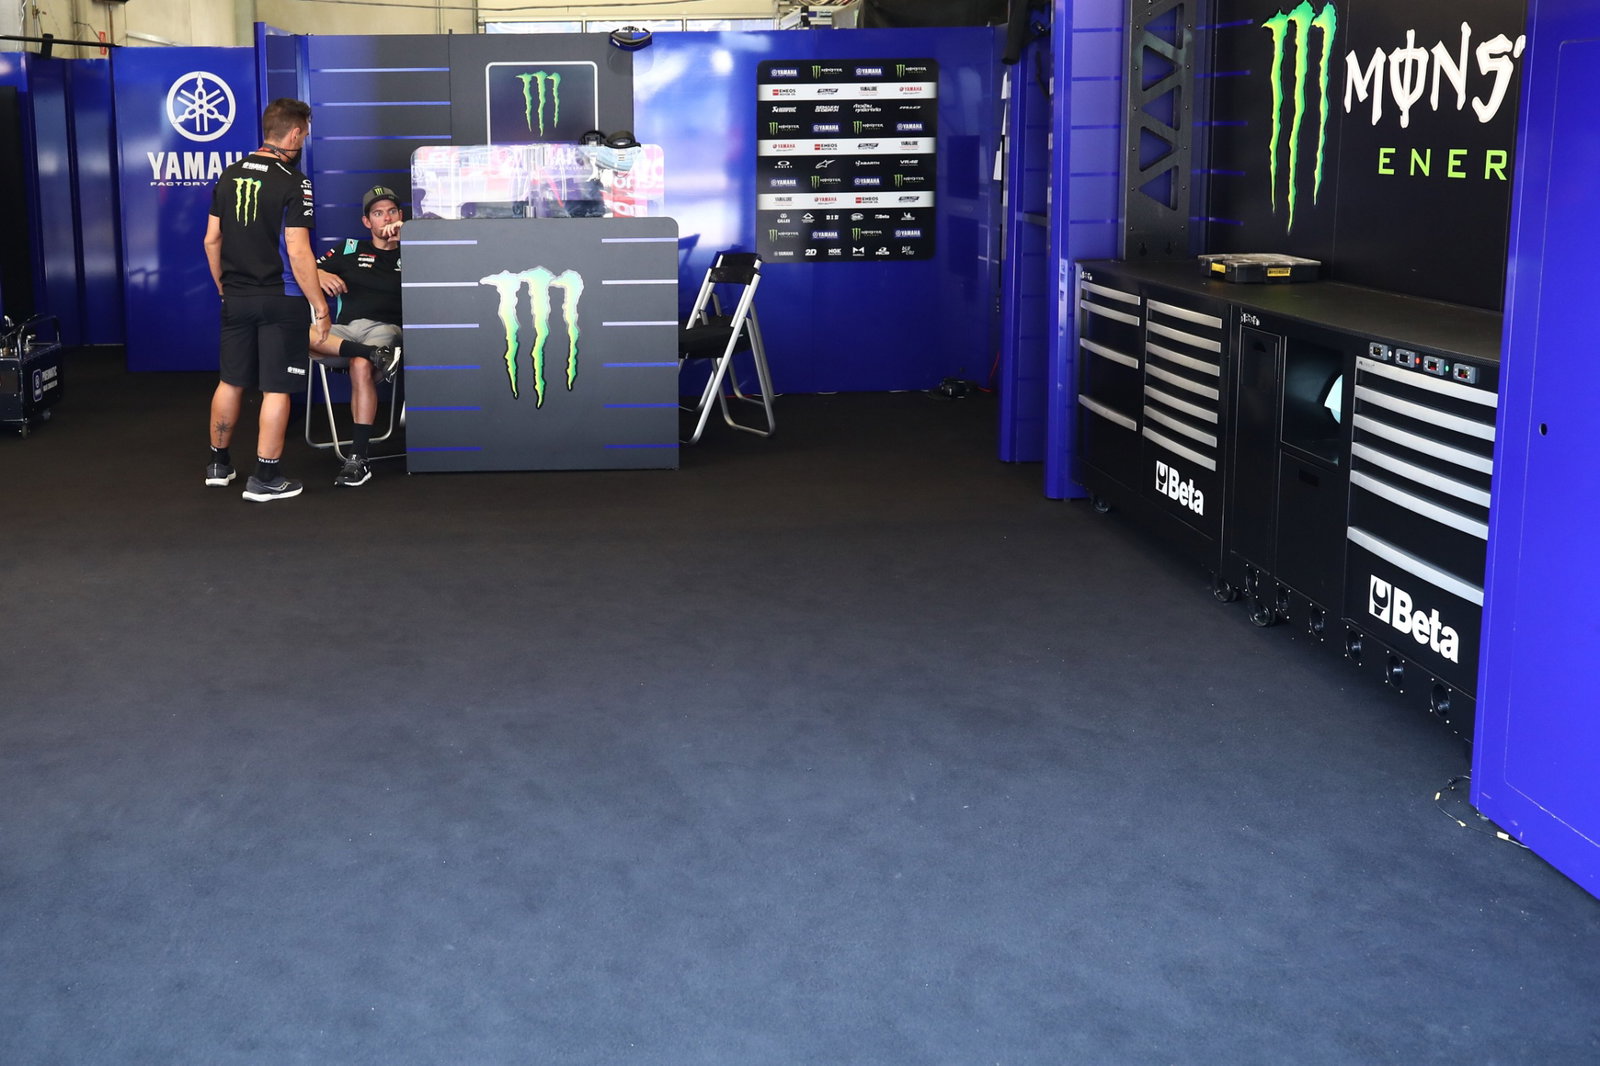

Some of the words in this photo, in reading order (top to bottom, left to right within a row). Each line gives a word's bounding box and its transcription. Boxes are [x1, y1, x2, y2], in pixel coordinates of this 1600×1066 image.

[1344, 22, 1526, 128] MONS
[147, 151, 257, 180] YAMAH
[1378, 147, 1507, 181] ENER
[805, 248, 817, 256] 2D
[1168, 466, 1204, 516] Beta
[1392, 586, 1460, 664] Beta
